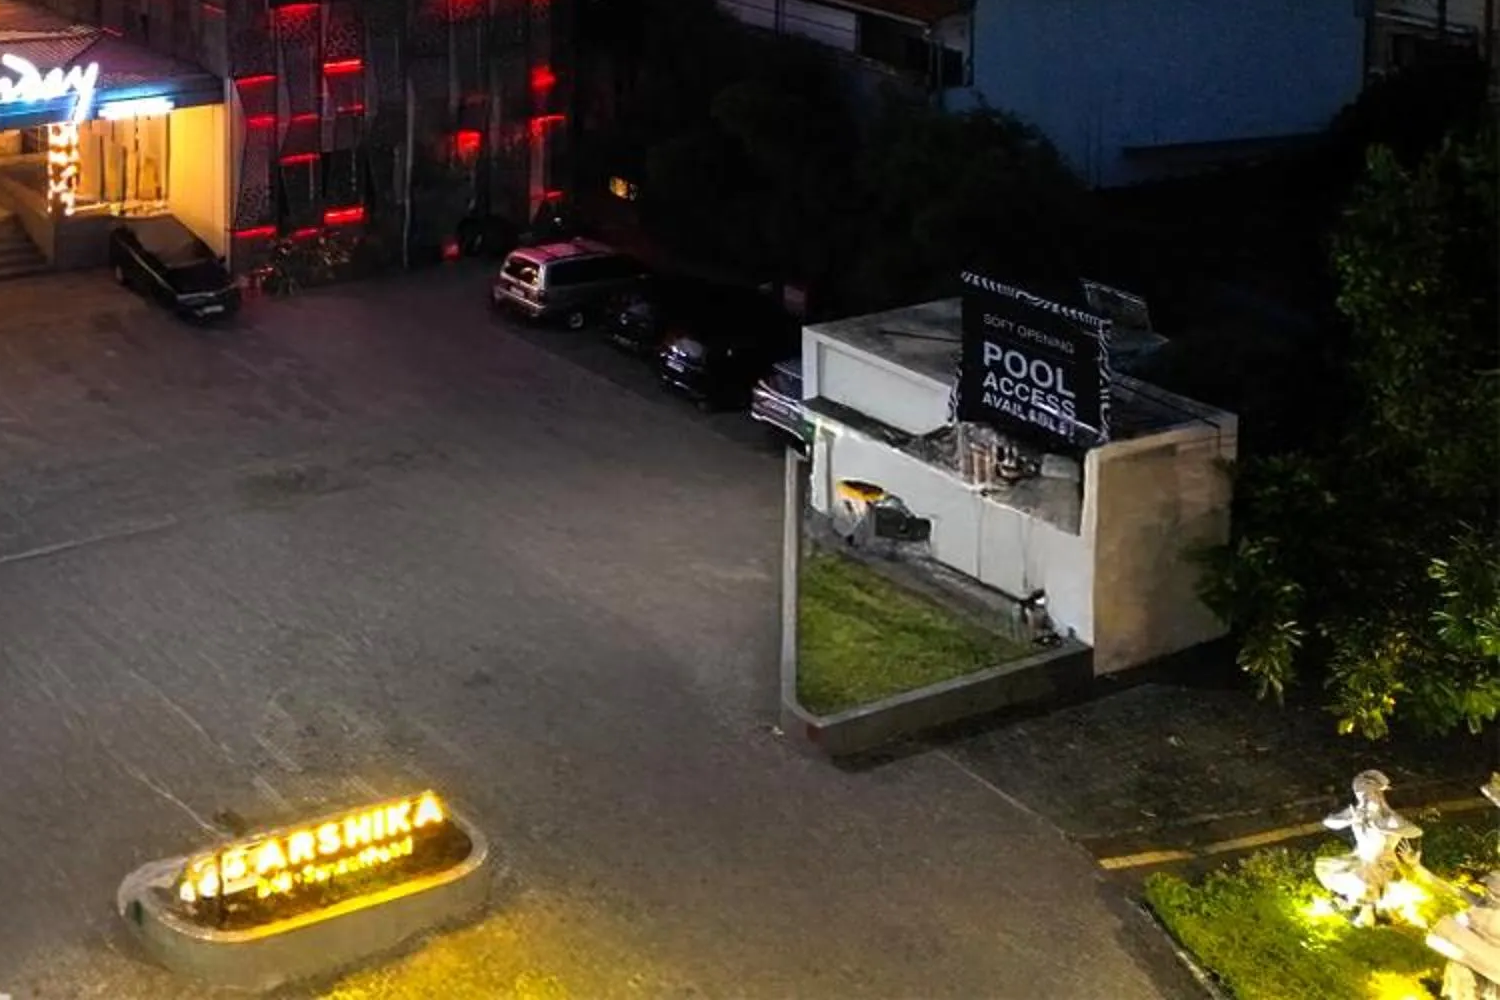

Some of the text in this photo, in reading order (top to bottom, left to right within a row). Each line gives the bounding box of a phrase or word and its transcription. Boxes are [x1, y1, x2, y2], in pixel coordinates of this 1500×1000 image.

[1016, 324, 1076, 355] OPENING
[982, 341, 1076, 399] POOL
[982, 370, 1076, 418] ACCESS
